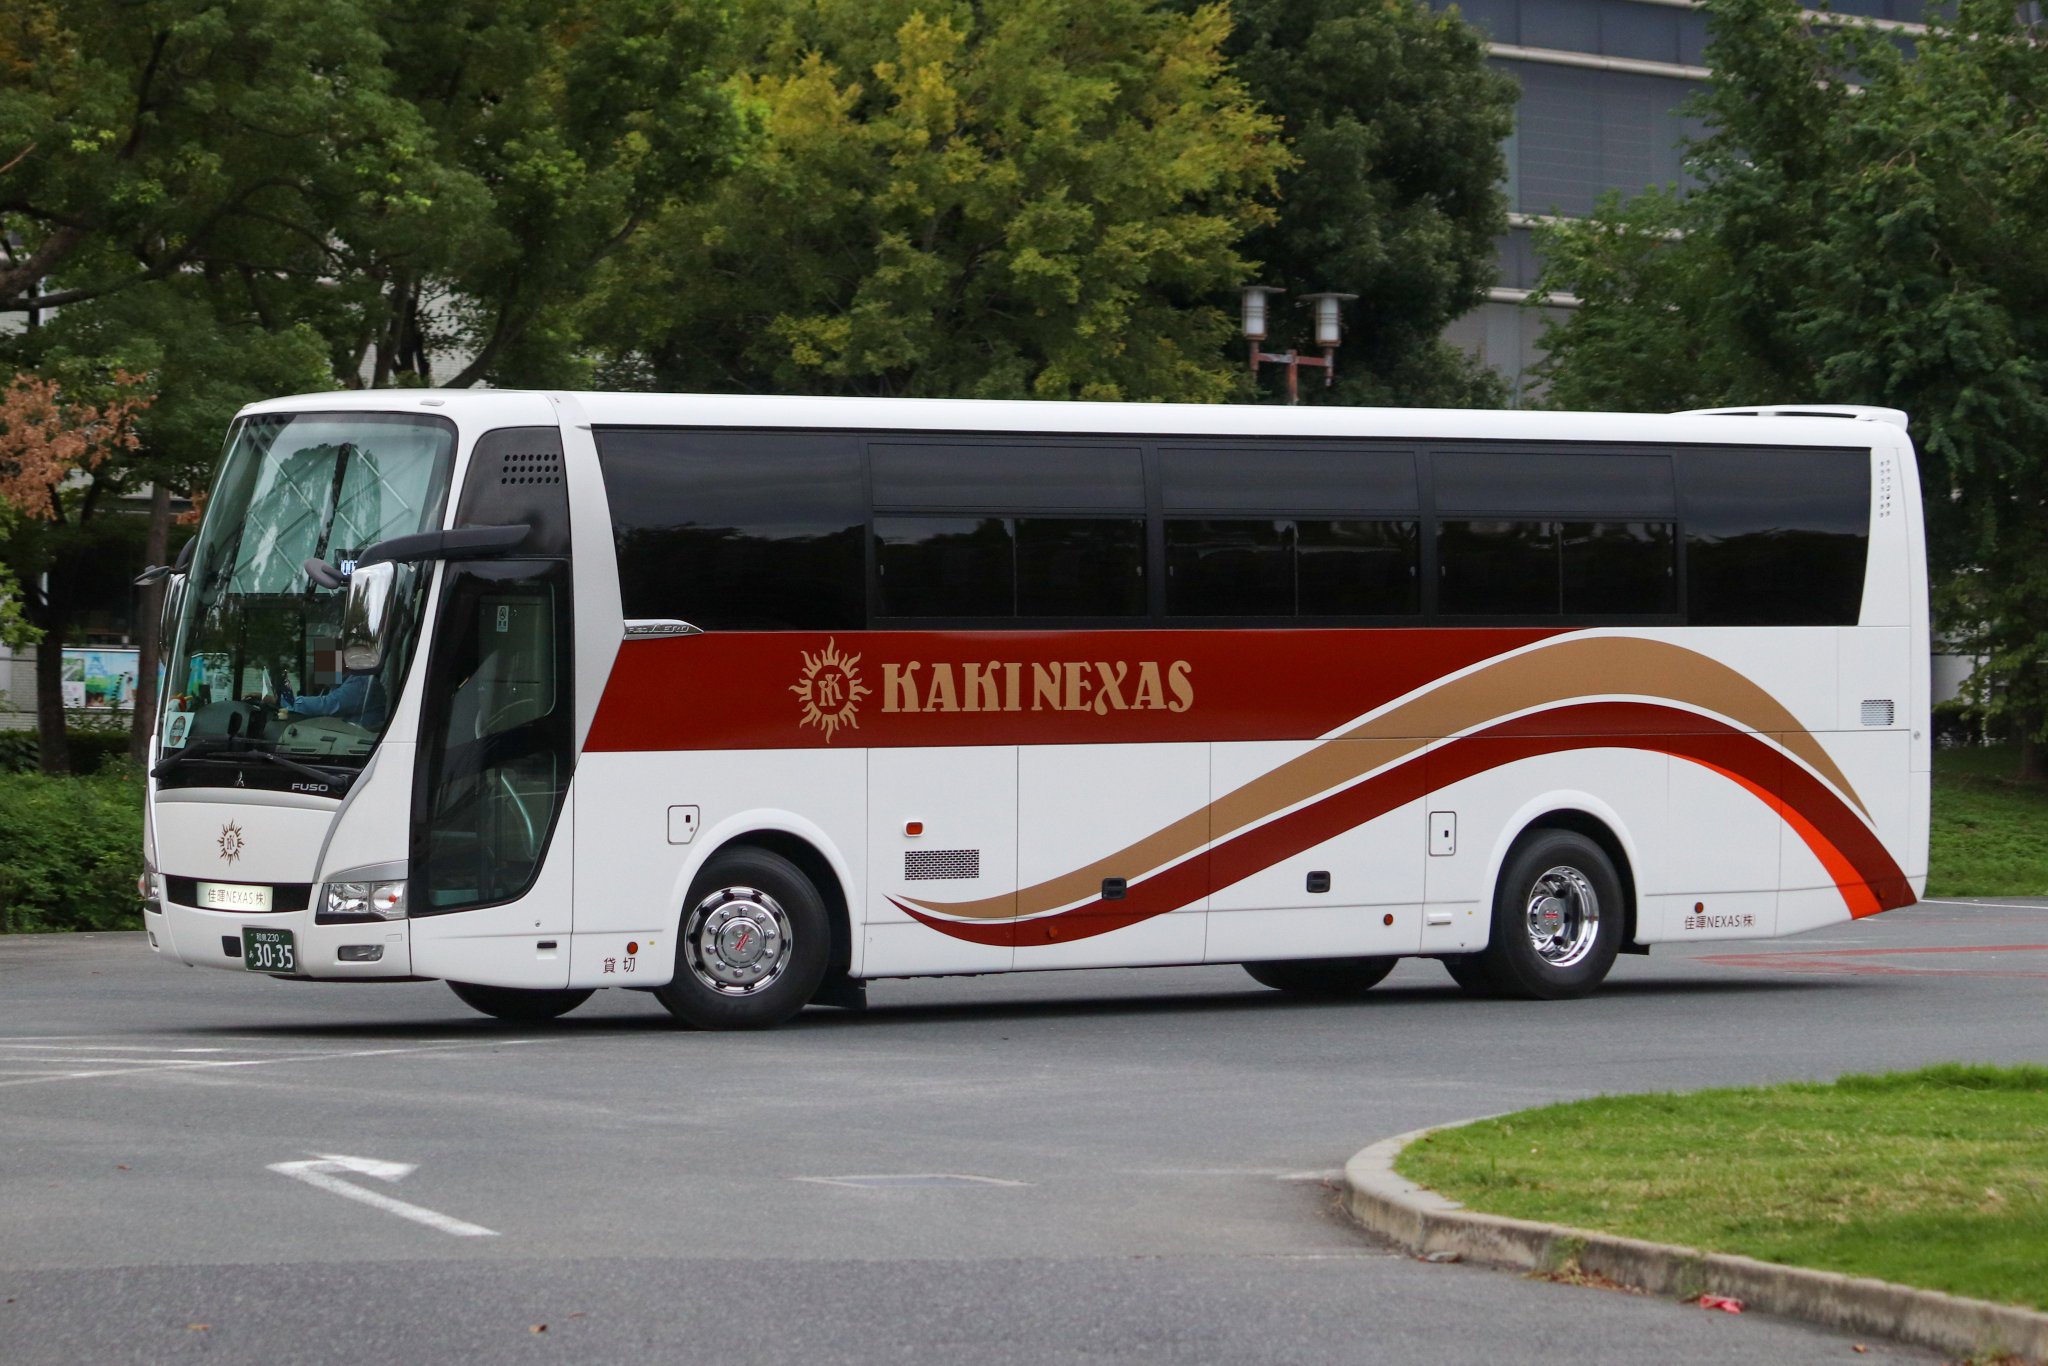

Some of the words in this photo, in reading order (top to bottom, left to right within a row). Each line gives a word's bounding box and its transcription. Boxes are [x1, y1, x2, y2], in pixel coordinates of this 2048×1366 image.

[881, 660, 1022, 713] KAKI
[1031, 660, 1194, 716] NEXAS
[291, 783, 329, 792] FUSO
